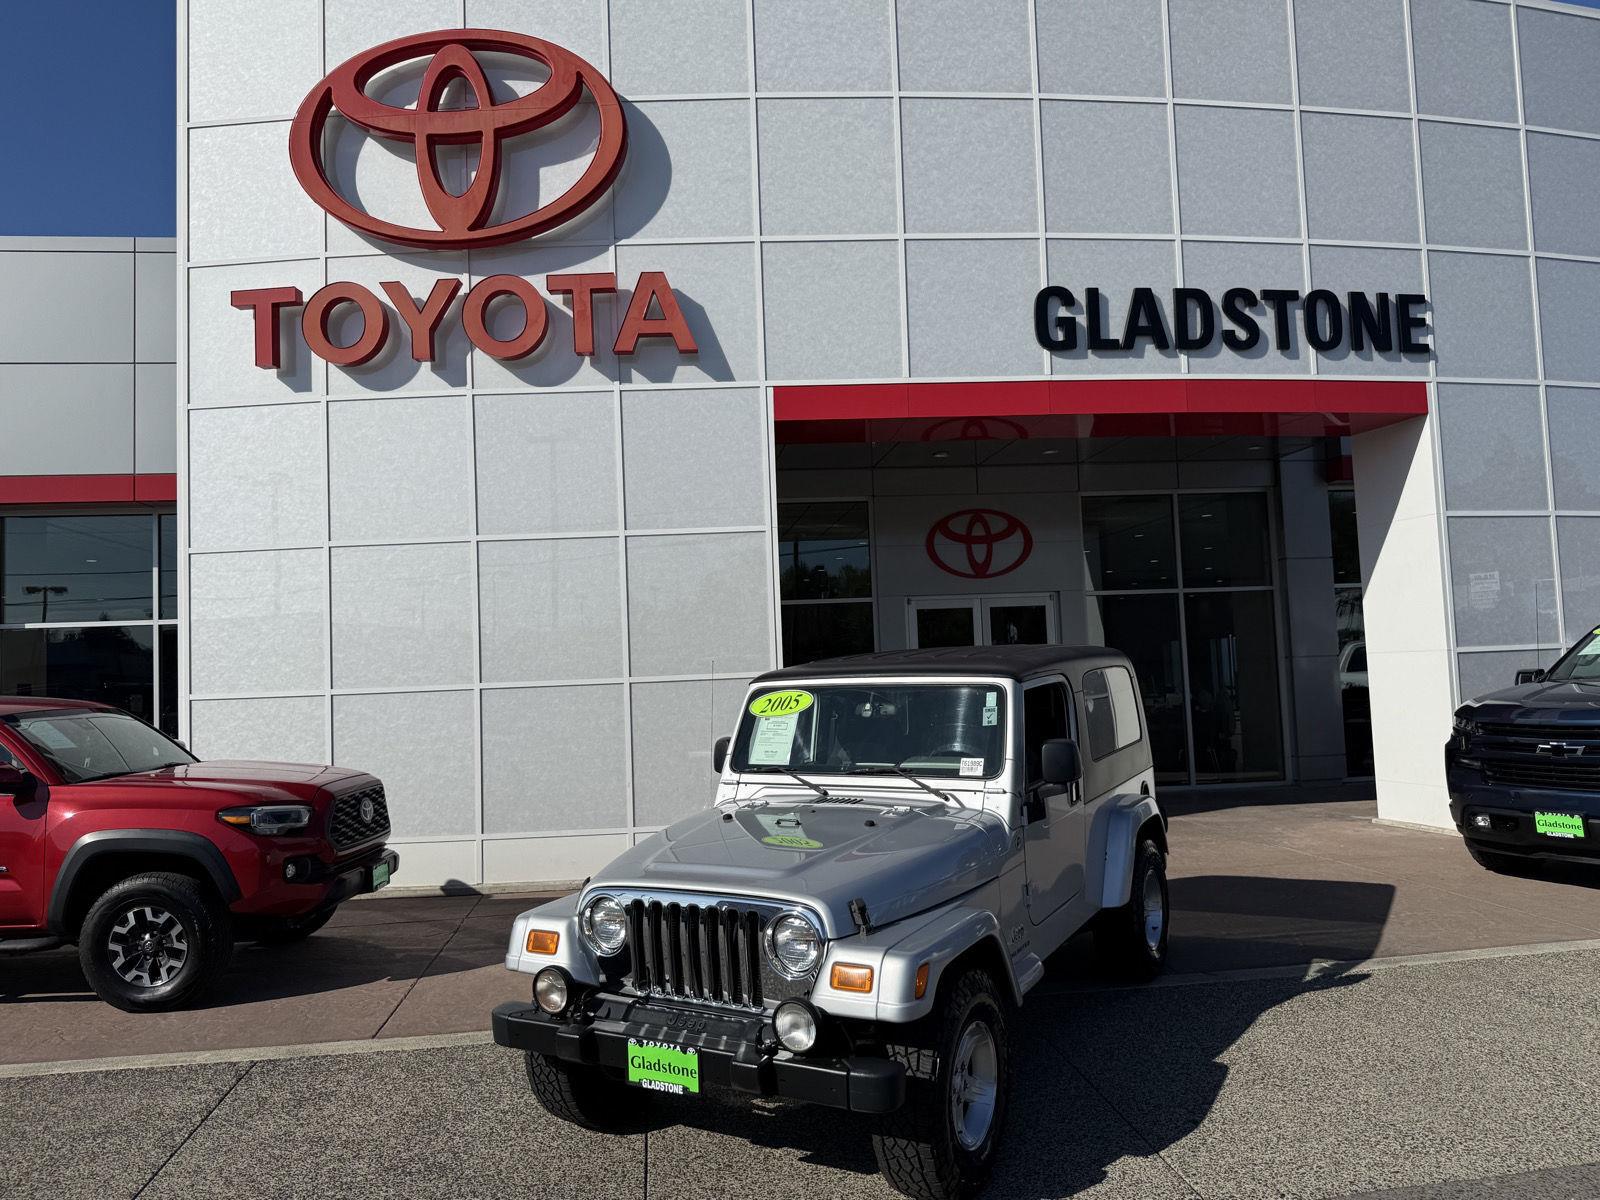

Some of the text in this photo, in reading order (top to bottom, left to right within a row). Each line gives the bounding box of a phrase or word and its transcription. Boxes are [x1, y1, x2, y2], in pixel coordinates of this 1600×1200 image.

[230, 271, 699, 369] TOYOTA
[1033, 285, 1430, 353] GLADSTONE
[759, 694, 804, 714] 2005
[1537, 819, 1582, 830] Gladstone
[666, 1013, 707, 1032] Jeep
[642, 1040, 681, 1052] TOYOTA
[630, 1055, 697, 1079] Gladstone
[642, 1079, 683, 1094] GLADSTONE
